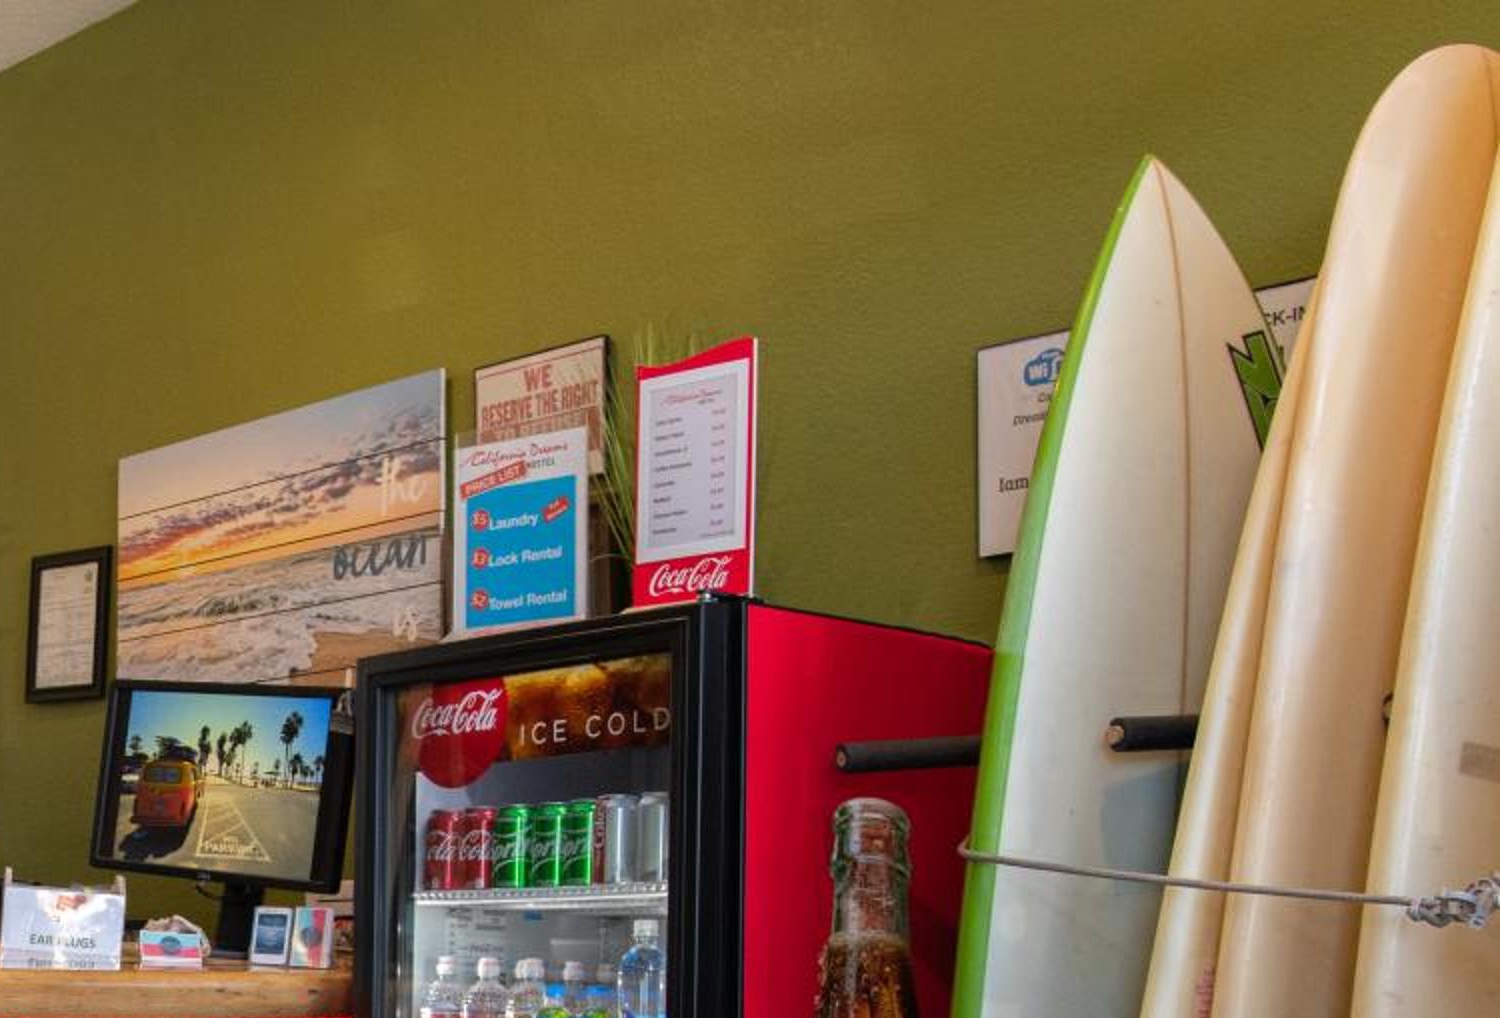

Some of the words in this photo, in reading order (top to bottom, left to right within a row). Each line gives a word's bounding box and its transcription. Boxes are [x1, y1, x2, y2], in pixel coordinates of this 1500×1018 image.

[523, 364, 552, 392] WE
[481, 396, 533, 421] RESERVE
[536, 389, 558, 416] THE
[562, 379, 599, 410] RIGHT
[489, 513, 539, 531] Laundry
[332, 535, 427, 581] ocean
[489, 552, 518, 567] Lock
[521, 546, 563, 563] Rental
[649, 555, 733, 597] Coca-Cola
[489, 596, 524, 611] Towel
[527, 588, 567, 606] Rental
[412, 689, 502, 739] Coca-Cola
[518, 719, 568, 746] ICE
[585, 707, 671, 738] COLD
[28, 933, 54, 946] EAR
[57, 935, 97, 949] LUGS
